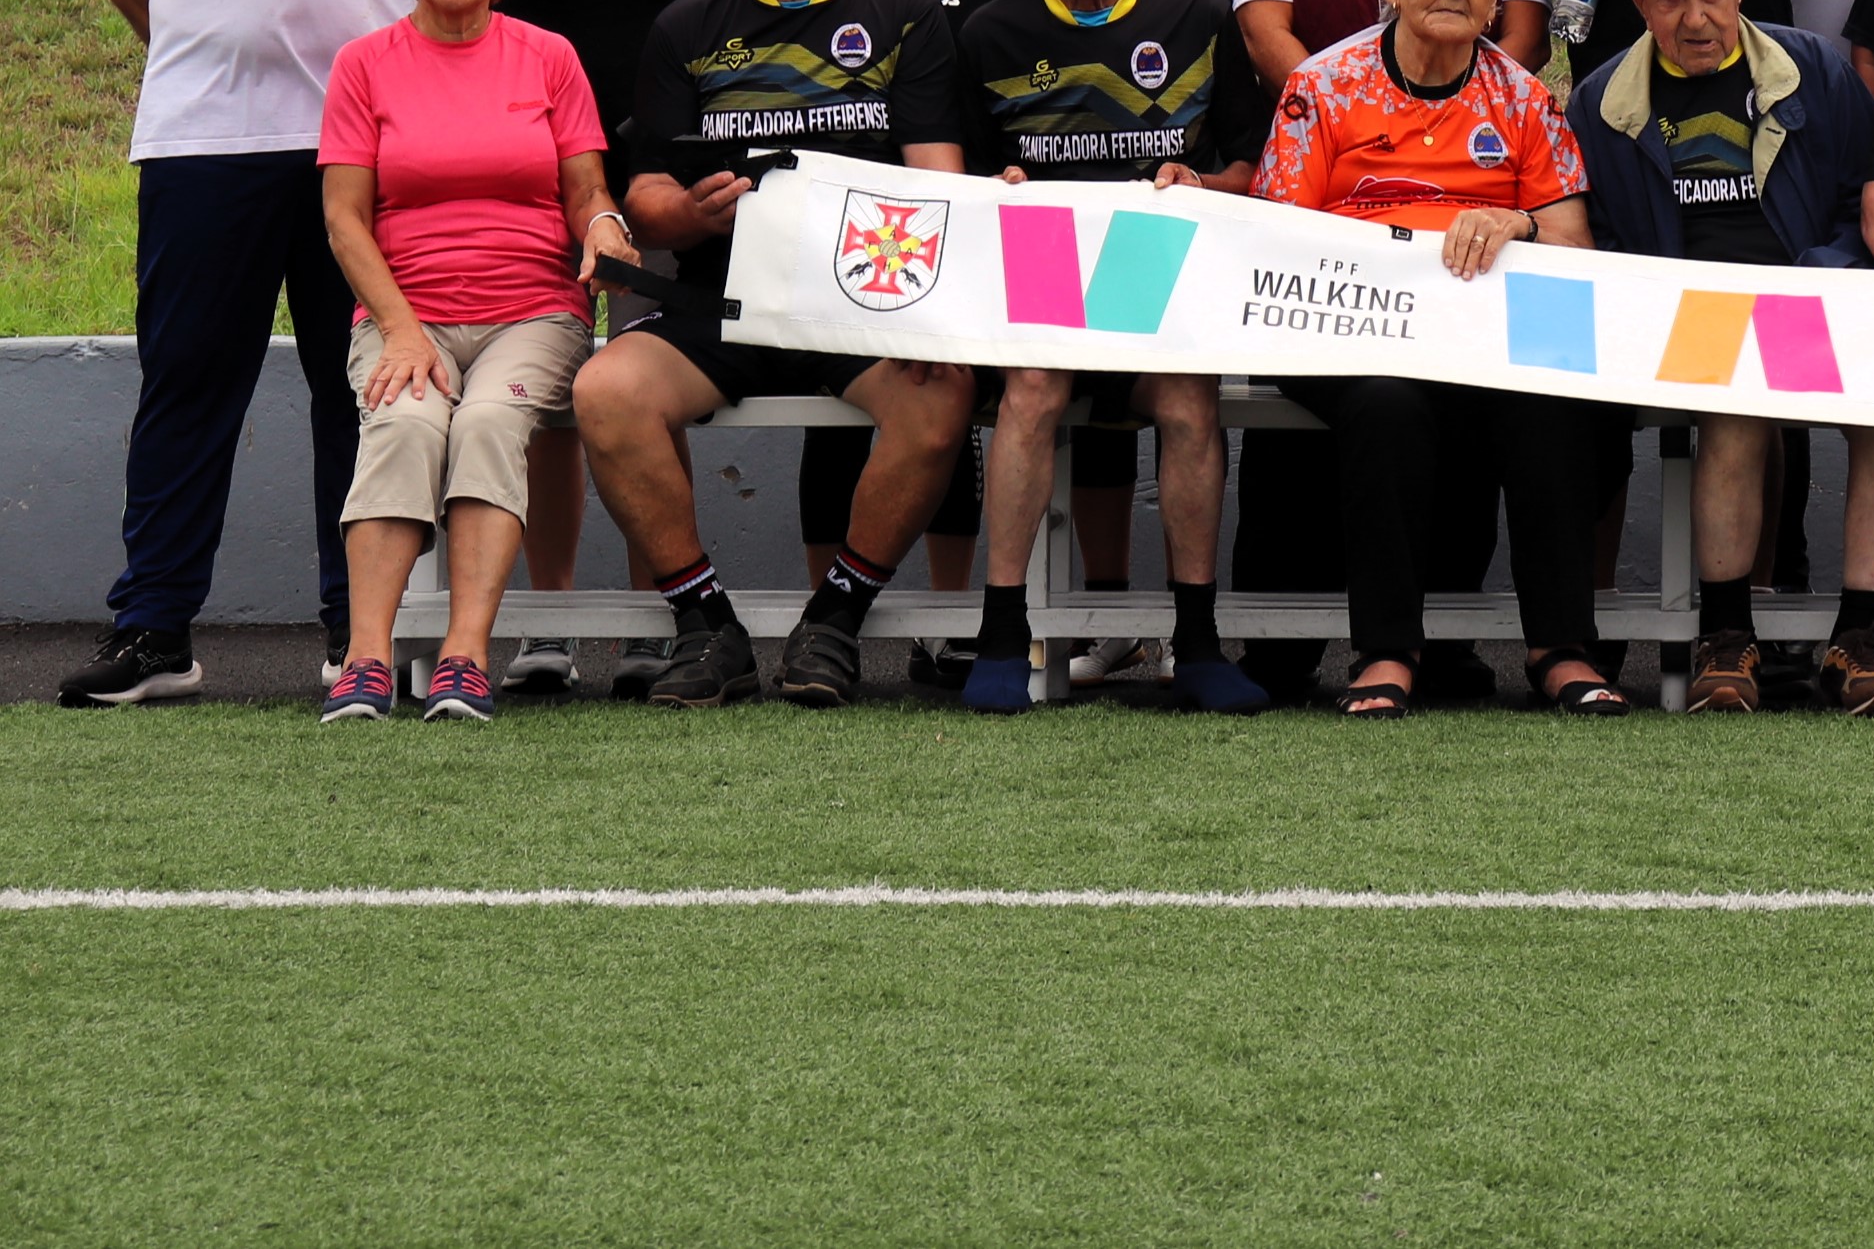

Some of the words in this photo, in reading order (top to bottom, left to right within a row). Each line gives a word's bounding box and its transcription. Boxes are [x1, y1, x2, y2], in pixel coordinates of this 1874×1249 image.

[718, 52, 752, 63] SPORT
[1031, 73, 1058, 84] SPORT
[702, 110, 805, 140] PANIFICADORA
[808, 102, 889, 133] FETEIRENSE
[1111, 128, 1184, 160] FETEIRENSE
[1253, 268, 1415, 313] WALKING
[1242, 301, 1415, 339] FOOTBALL
